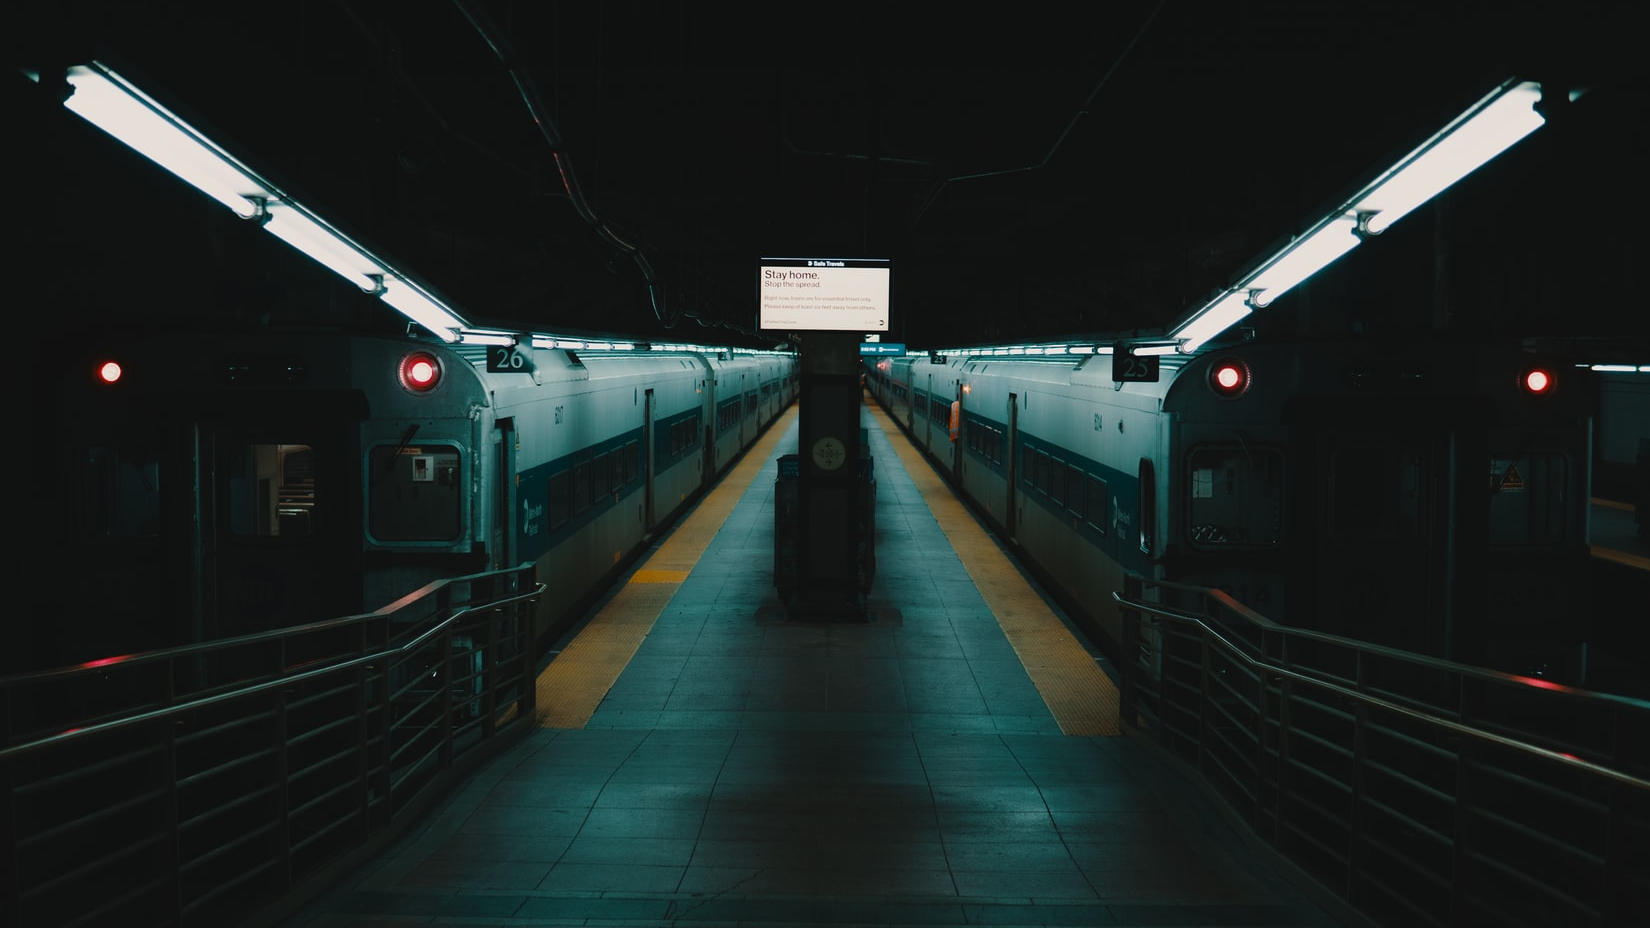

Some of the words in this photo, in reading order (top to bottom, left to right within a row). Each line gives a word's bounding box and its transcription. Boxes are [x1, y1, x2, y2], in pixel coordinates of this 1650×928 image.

[764, 269, 788, 280] Stay
[789, 270, 820, 280] home.
[496, 348, 524, 369] 26
[934, 355, 944, 364] 25
[1122, 357, 1149, 378] 25
